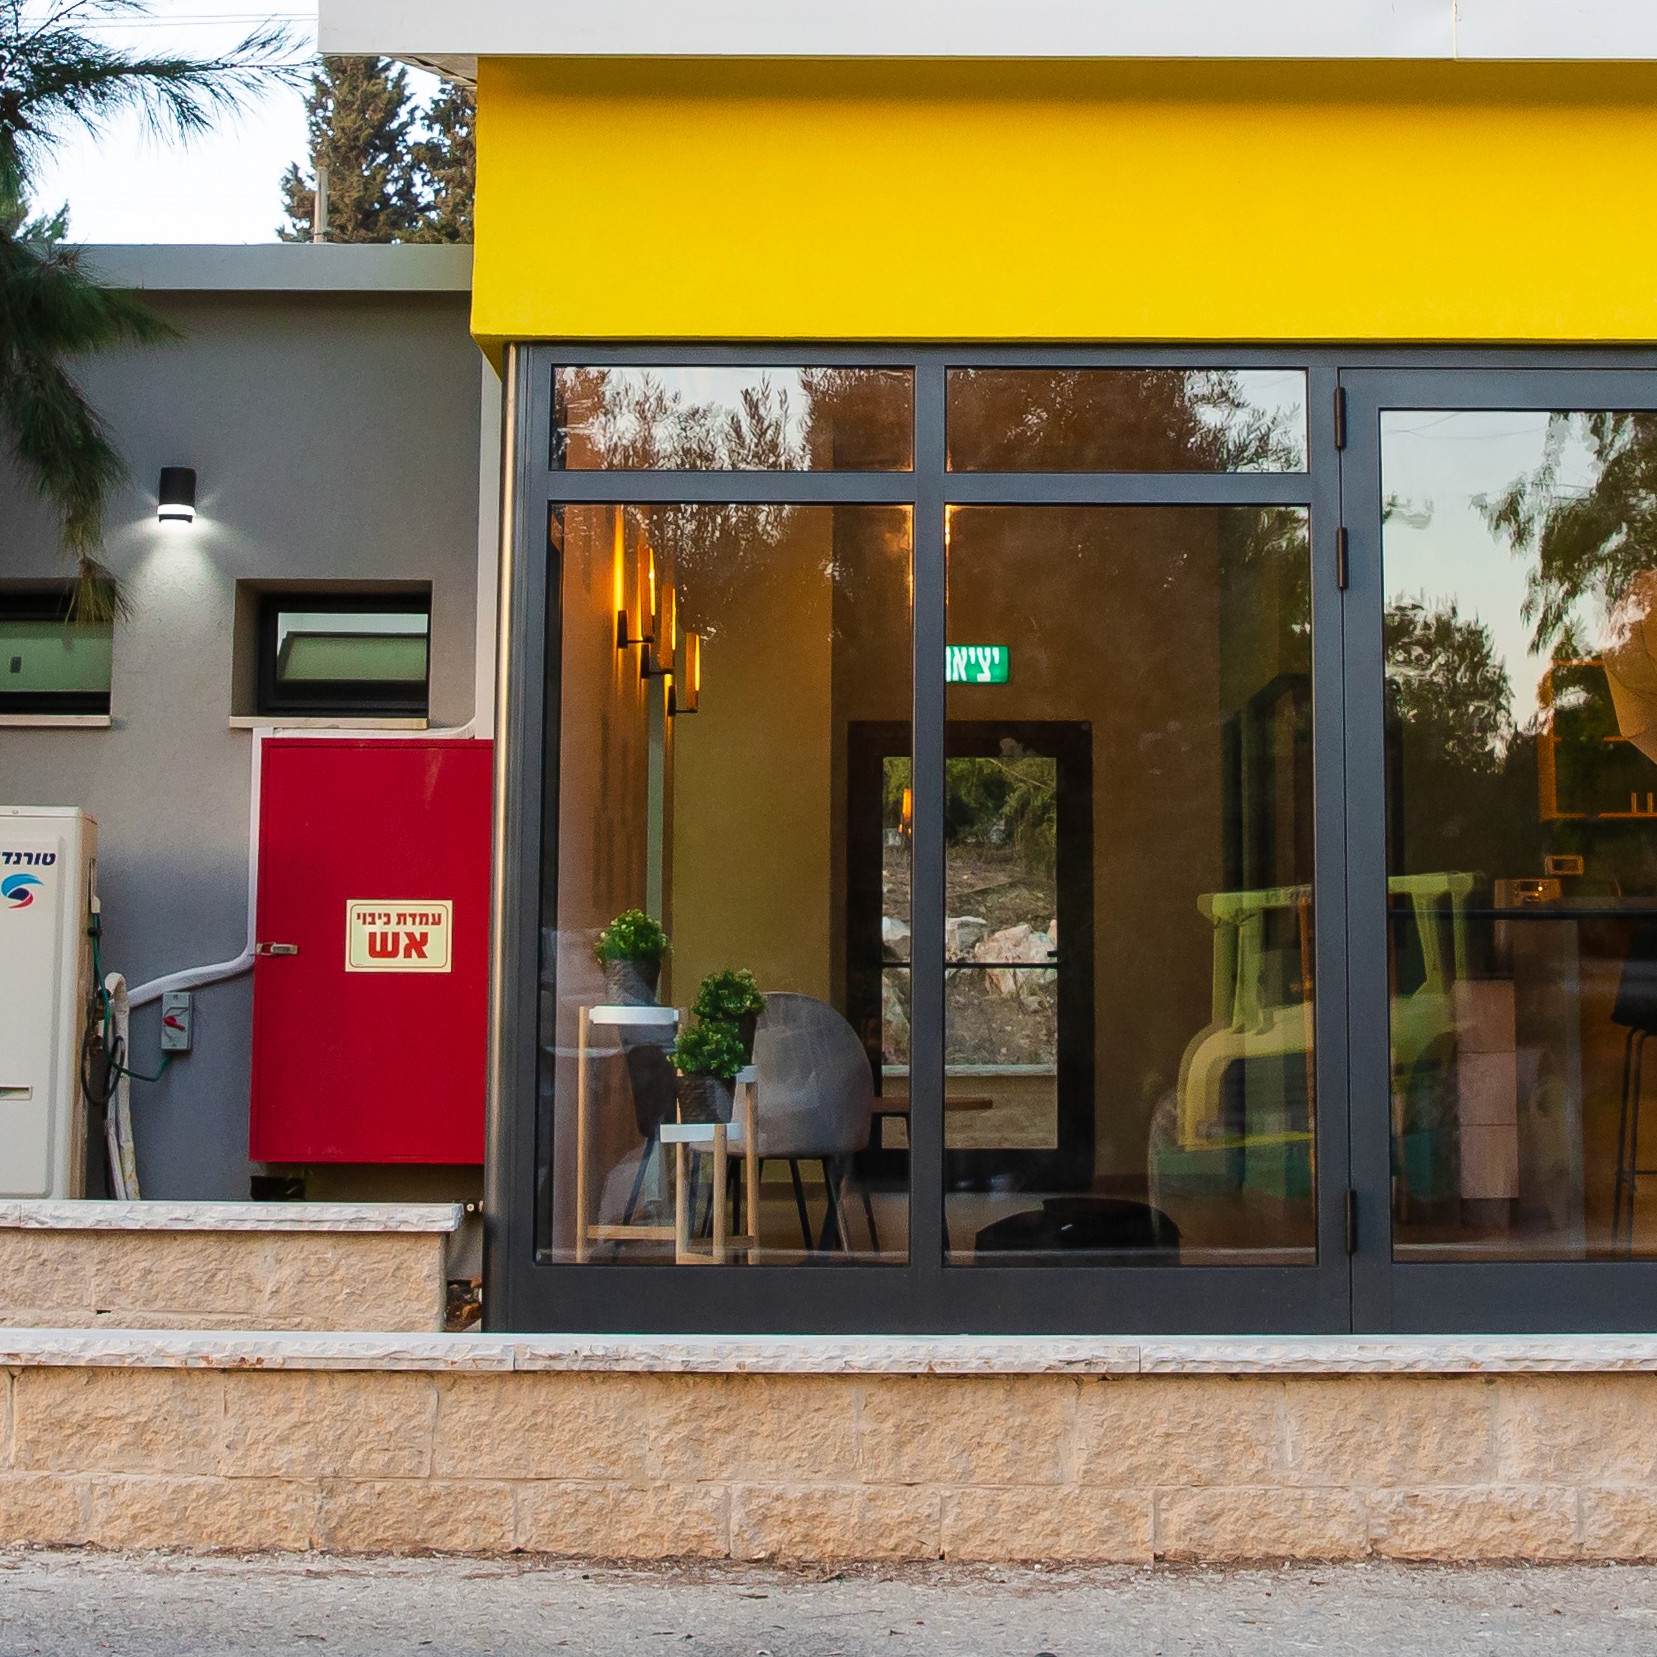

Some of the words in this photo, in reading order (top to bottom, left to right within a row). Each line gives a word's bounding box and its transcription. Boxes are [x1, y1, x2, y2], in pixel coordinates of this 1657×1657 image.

[356, 912, 392, 926] כיבוי
[396, 912, 442, 926] עמדת
[368, 931, 429, 959] אש
